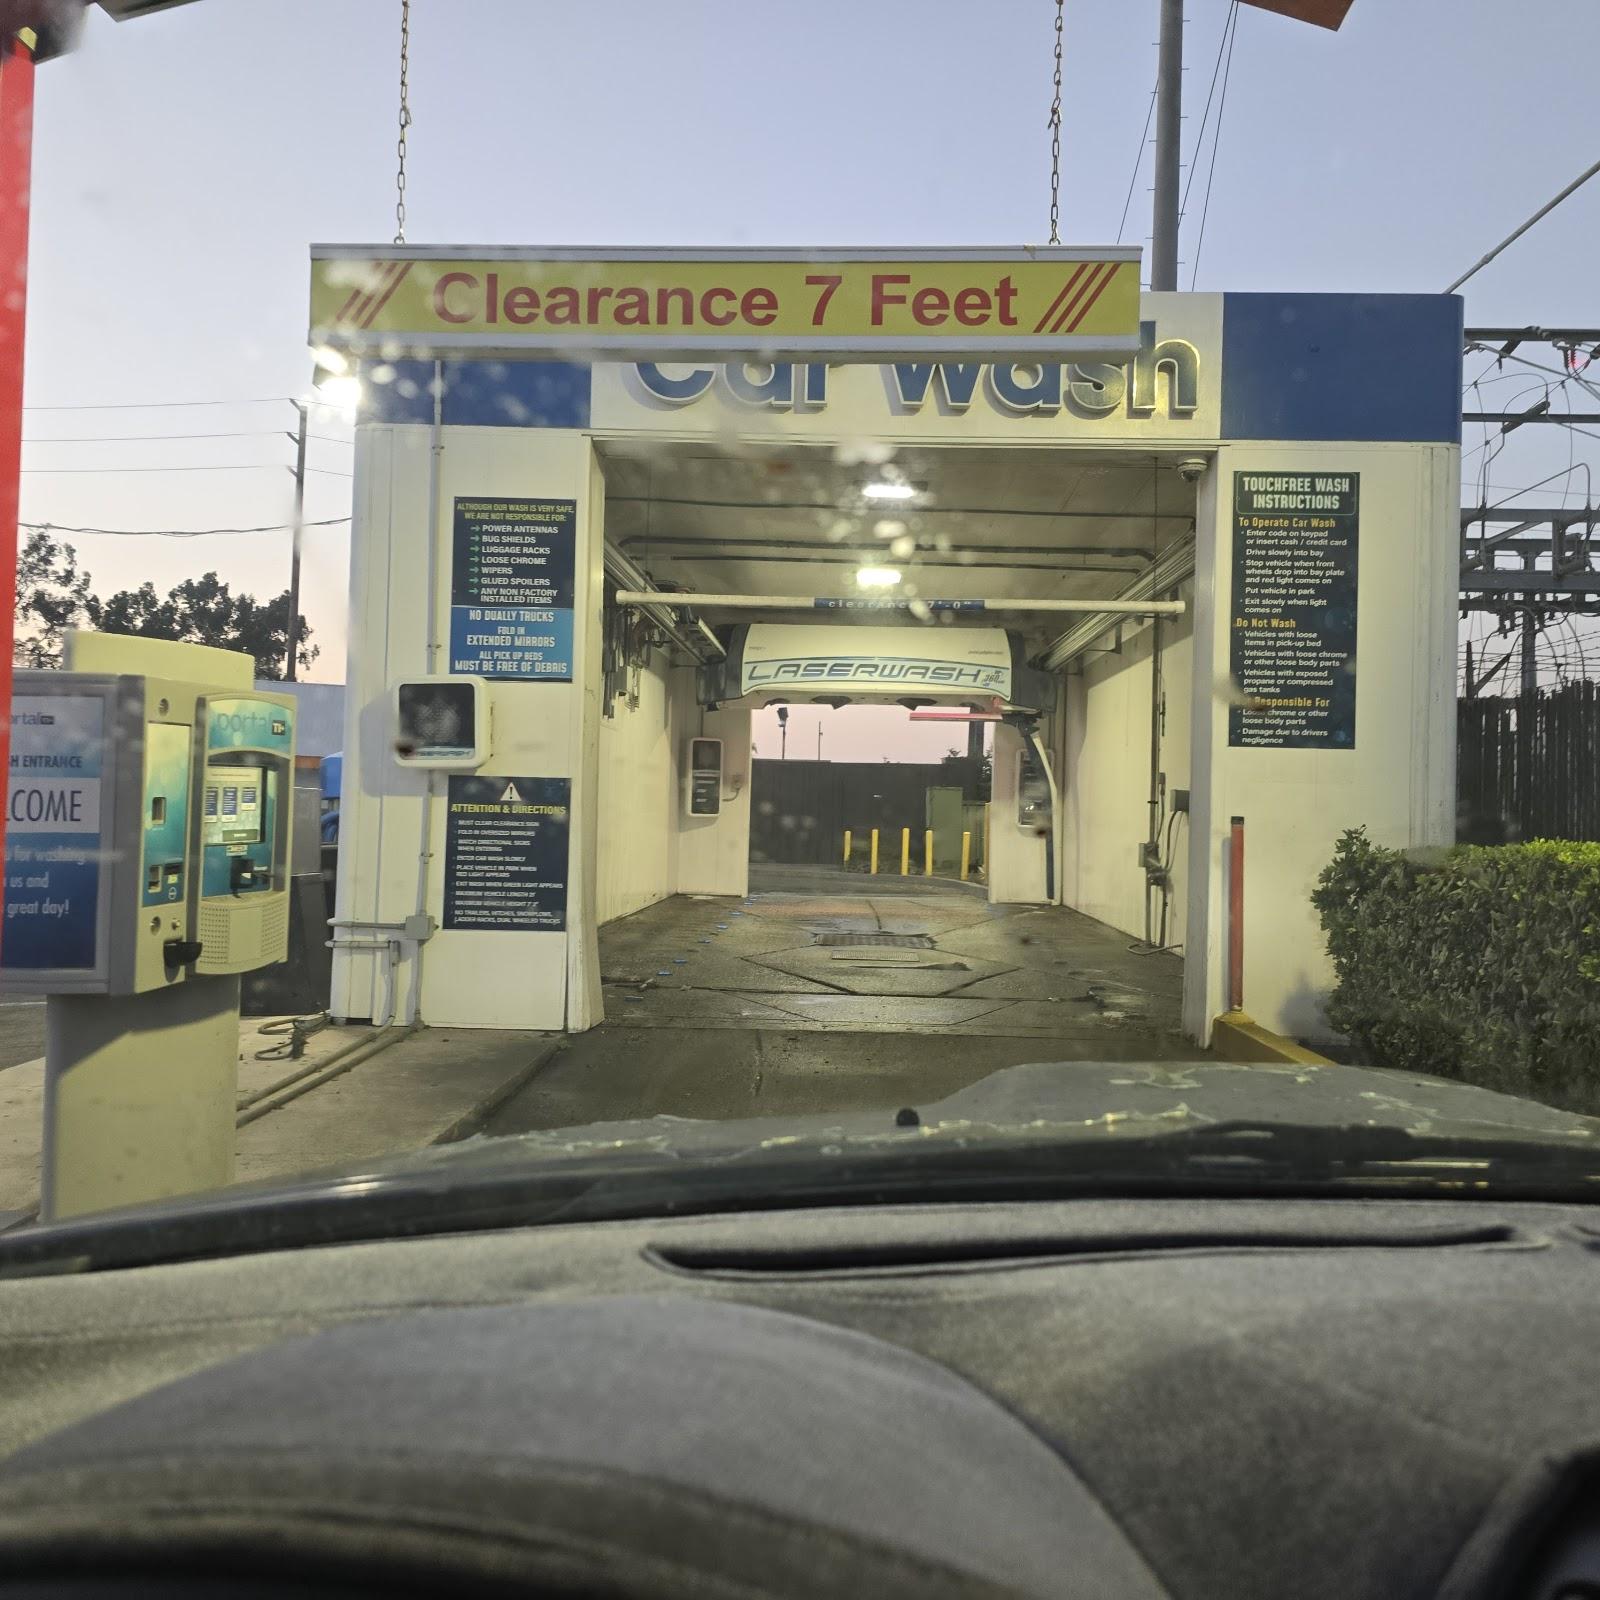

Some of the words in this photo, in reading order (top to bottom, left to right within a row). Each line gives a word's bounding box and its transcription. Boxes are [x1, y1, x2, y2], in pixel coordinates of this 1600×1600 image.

[433, 271, 778, 327] Clearance
[804, 275, 843, 326] 7
[870, 274, 1018, 327] Feet
[1243, 477, 1311, 491] TOUCHFREE
[1315, 478, 1349, 492] WASH
[457, 503, 492, 511] ALTHOUGH
[1253, 495, 1339, 509] INSTRUCTIONS
[1239, 518, 1249, 527] To
[1252, 518, 1289, 528] Operate
[1293, 518, 1308, 527] Car
[1311, 519, 1336, 527] Wash
[482, 546, 521, 554] LUGGAGE
[1268, 549, 1292, 557] slowly
[480, 595, 525, 603] INSTALLED
[829, 600, 916, 609] clearanc
[469, 610, 482, 621] NO
[484, 611, 516, 621] DUALLY
[520, 612, 554, 622] TRUCKS
[1236, 618, 1248, 627] Do
[1252, 618, 1268, 627] Not
[1271, 619, 1296, 628] Wash
[498, 626, 515, 634] FOLD
[467, 635, 511, 646] EXTENDED
[514, 636, 555, 647] MIRRORS
[479, 651, 492, 659] ALL
[494, 651, 510, 659] PICK
[512, 652, 522, 660] UP
[524, 652, 543, 660] BEDS
[455, 660, 480, 671] MUST
[482, 661, 494, 671] BE
[497, 662, 518, 672] FREE
[521, 662, 532, 672] OF
[535, 662, 567, 673] DEBRIS
[747, 662, 983, 683] LASERWASH
[1316, 698, 1329, 706] For
[1242, 737, 1283, 745] negligence
[23, 756, 82, 768] ENTRANCE
[6, 789, 82, 822] COME
[451, 804, 501, 813] ATTENTION
[512, 805, 566, 815] DIRECTIONS
[7, 900, 39, 919] great
[42, 896, 70, 919] day!
